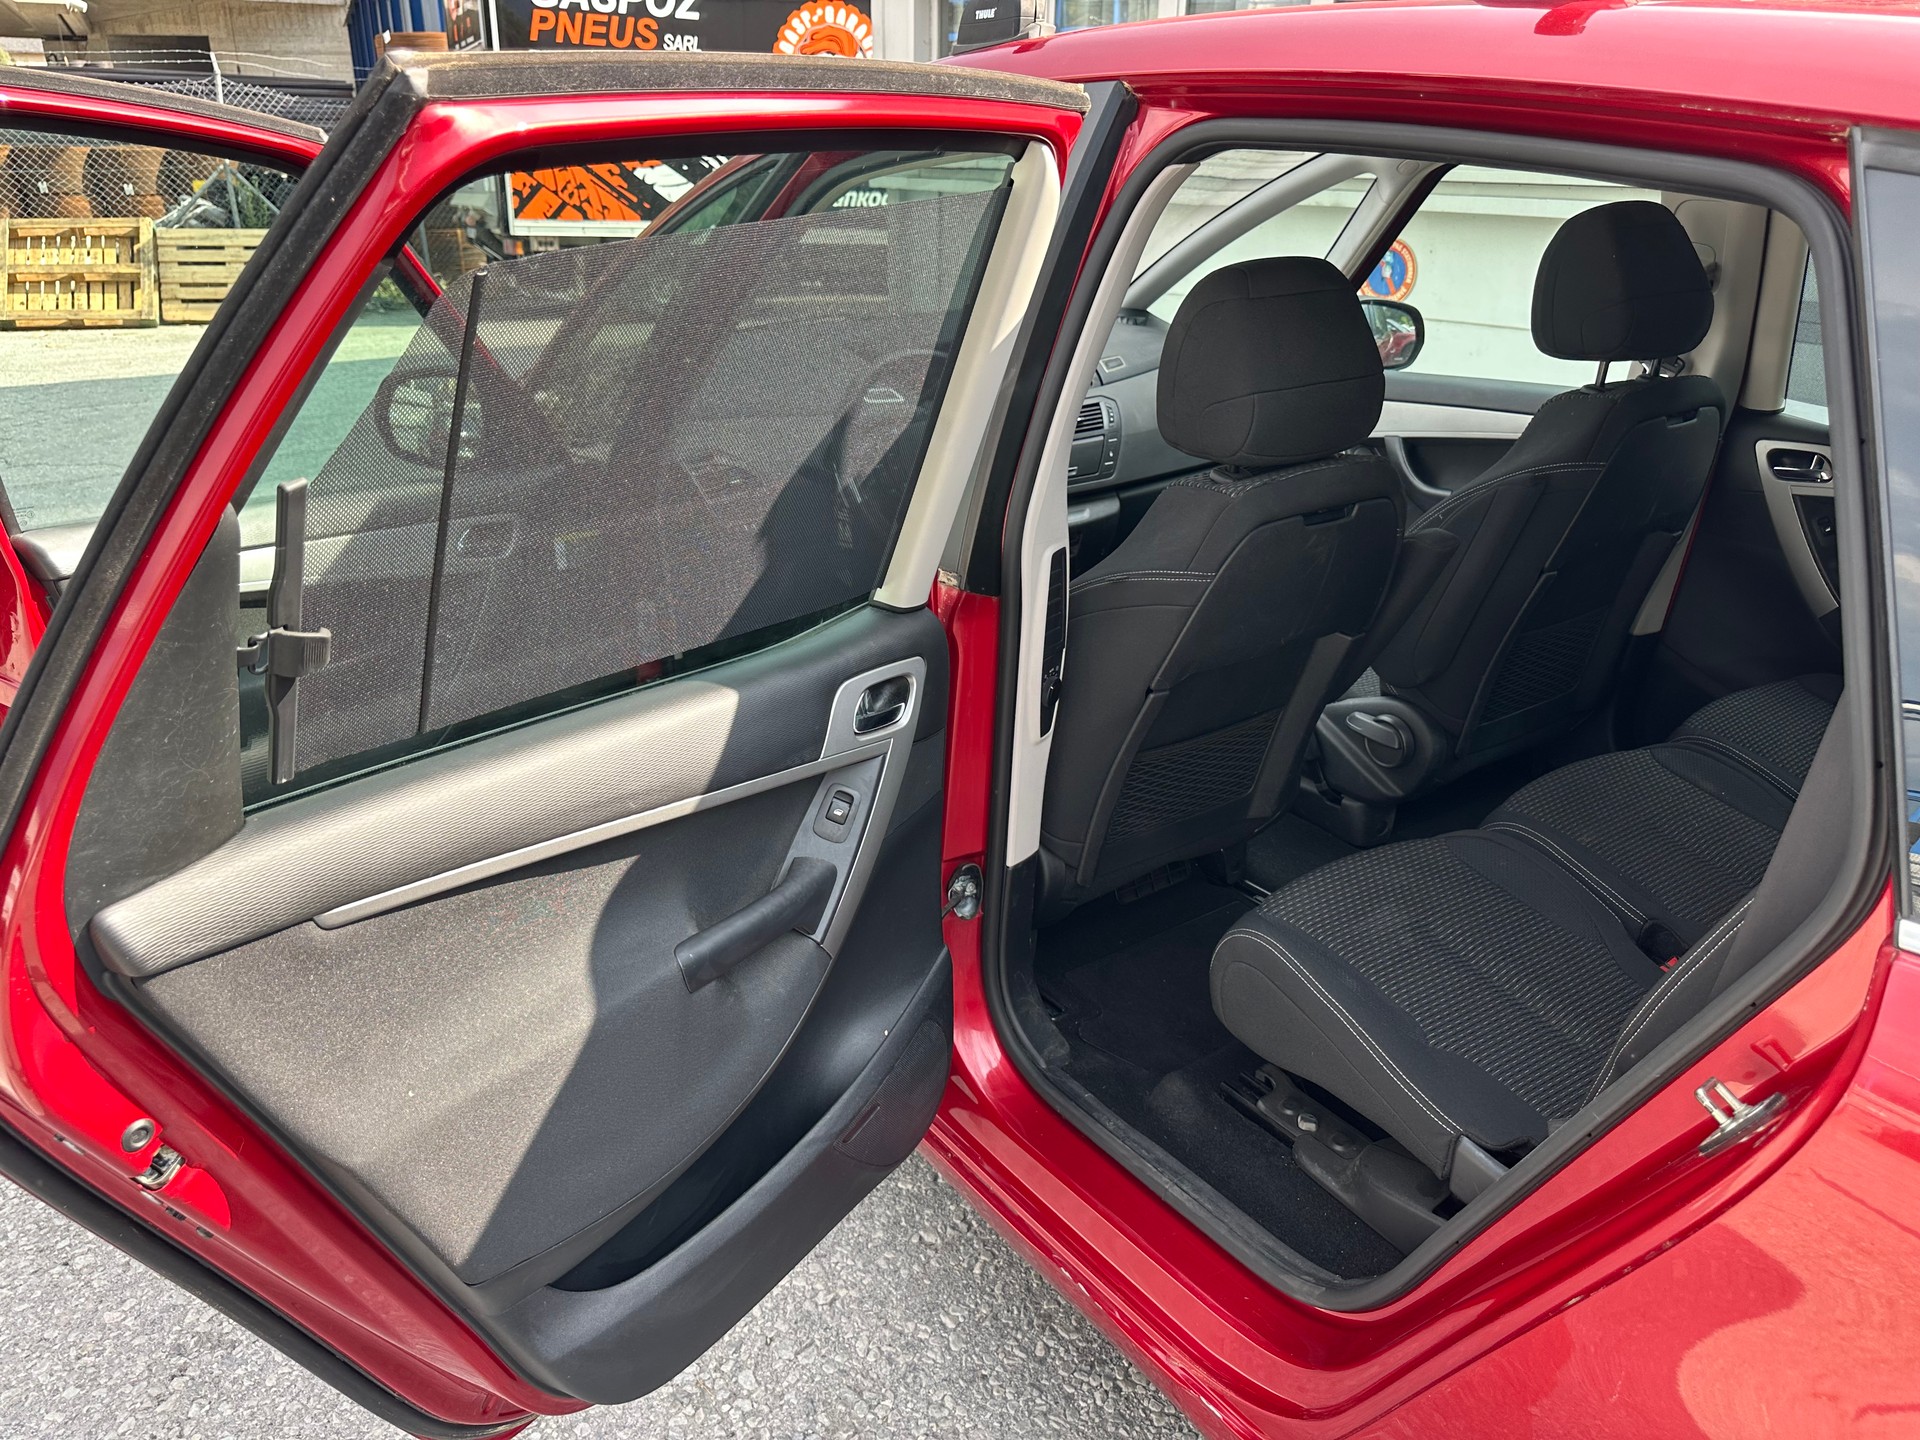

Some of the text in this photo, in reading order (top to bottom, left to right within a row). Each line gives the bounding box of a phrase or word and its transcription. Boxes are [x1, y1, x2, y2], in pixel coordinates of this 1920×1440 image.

[975, 9, 996, 20] THULE
[529, 8, 702, 52] PNEUS SARL
